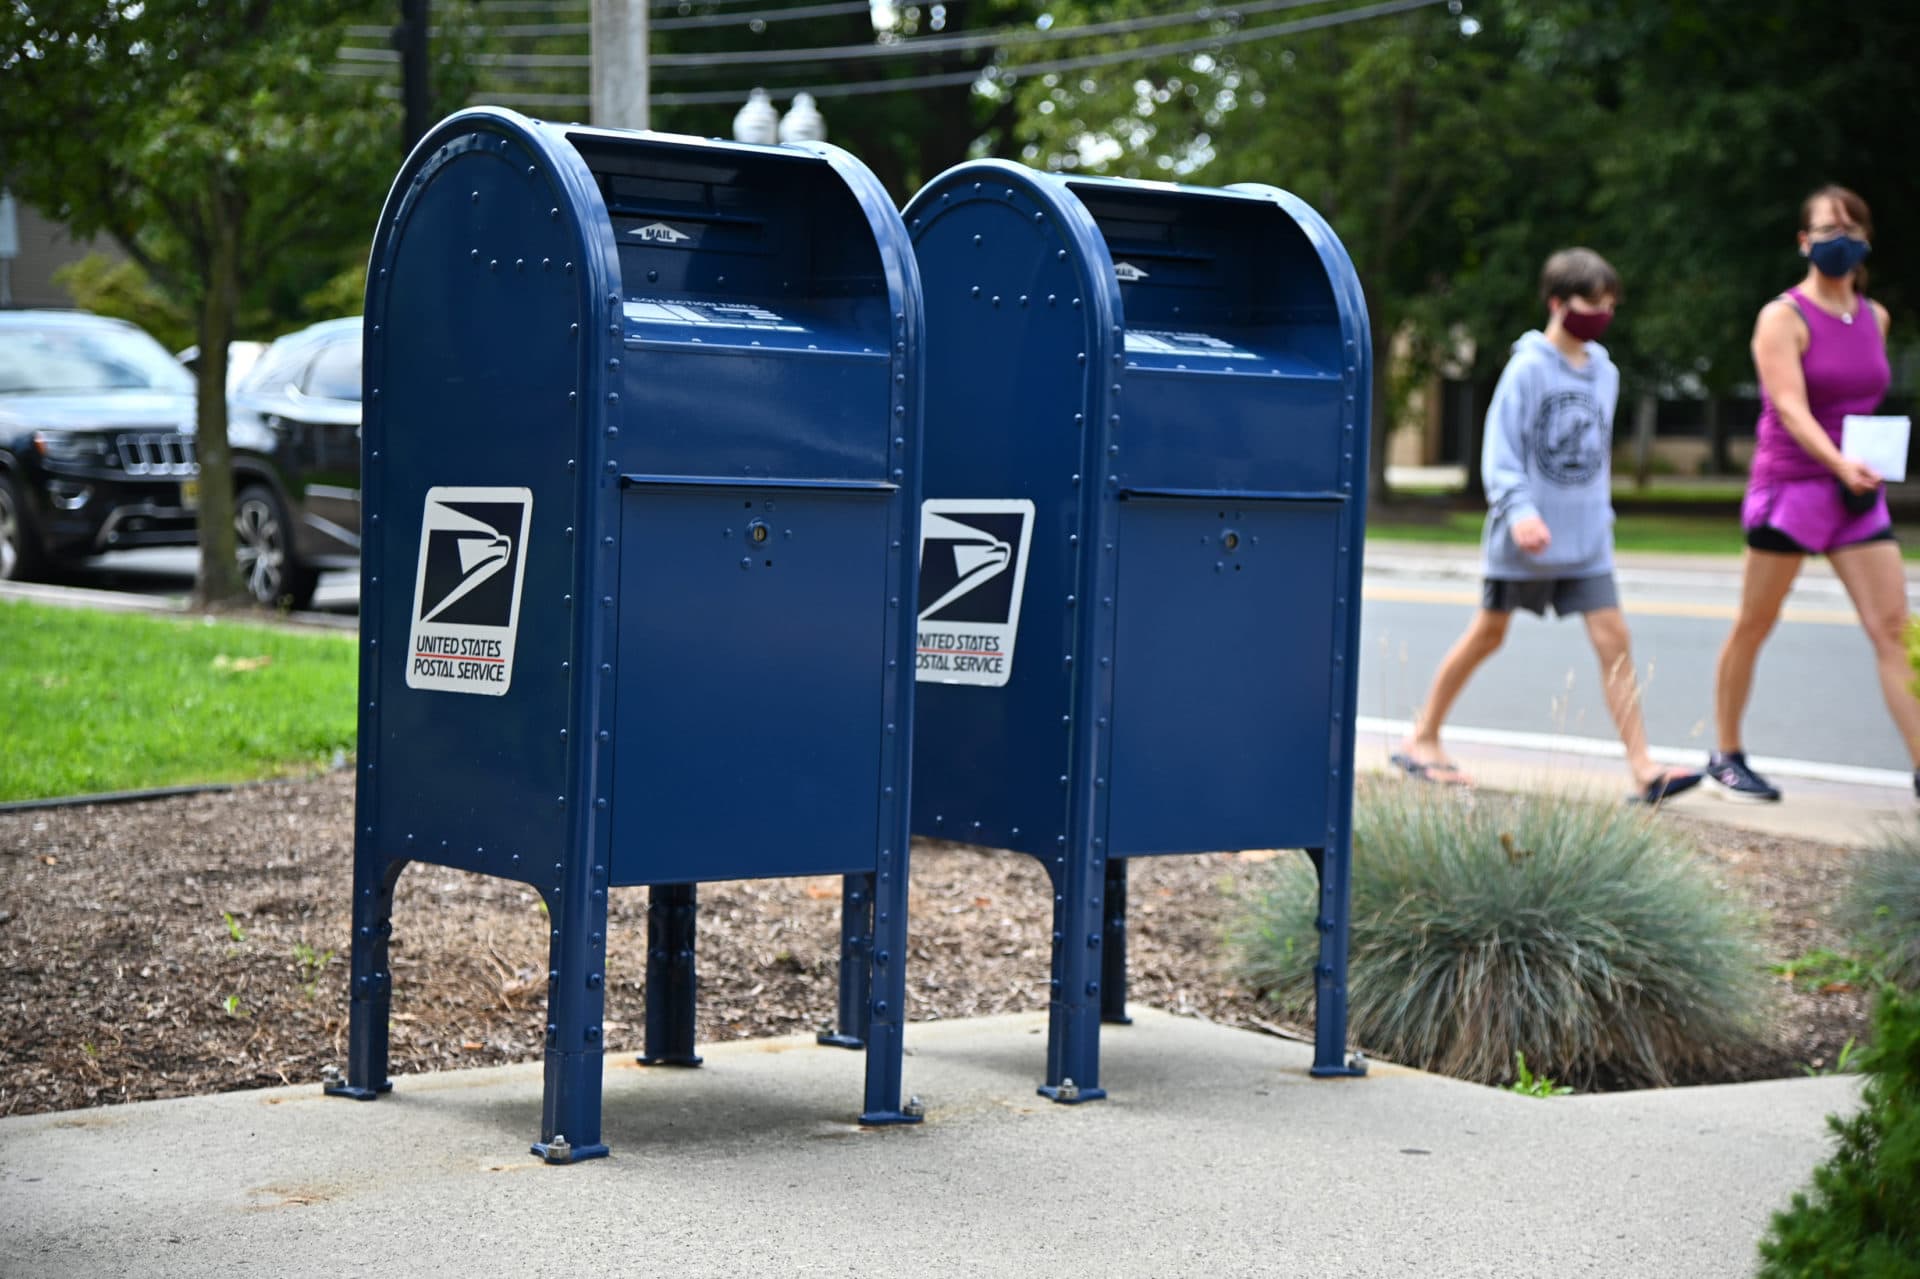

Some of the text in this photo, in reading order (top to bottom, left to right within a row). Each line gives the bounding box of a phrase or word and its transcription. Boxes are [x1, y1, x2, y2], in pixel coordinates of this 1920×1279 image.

[645, 228, 673, 240] MAIL
[416, 634, 502, 657] UNITED STATES
[917, 632, 1000, 652] NITED STATES
[413, 658, 505, 682] POSTAL SERVICE
[916, 653, 1004, 674] OSTAL SERVICE
